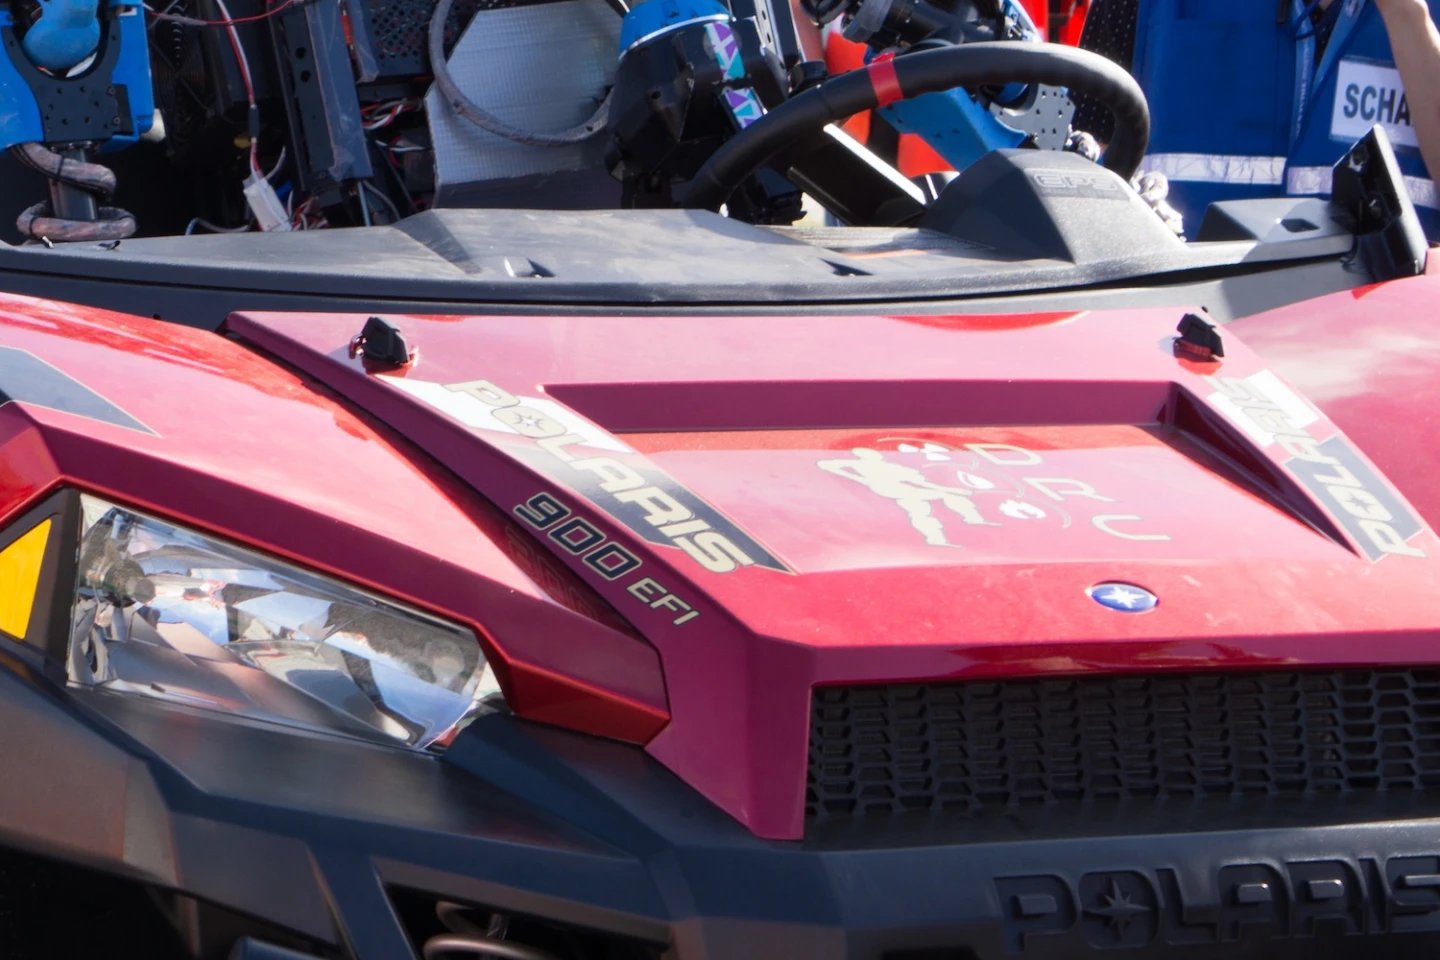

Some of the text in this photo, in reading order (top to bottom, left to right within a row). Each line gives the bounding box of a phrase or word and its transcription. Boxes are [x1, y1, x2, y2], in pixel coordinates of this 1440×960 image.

[1343, 82, 1415, 127] SCHA
[1033, 172, 1119, 191] EPS
[444, 379, 755, 574] POLARIS
[1201, 373, 1428, 558] POLARIS
[512, 492, 701, 627] 900 EFI
[992, 854, 1440, 953] POLARIS
